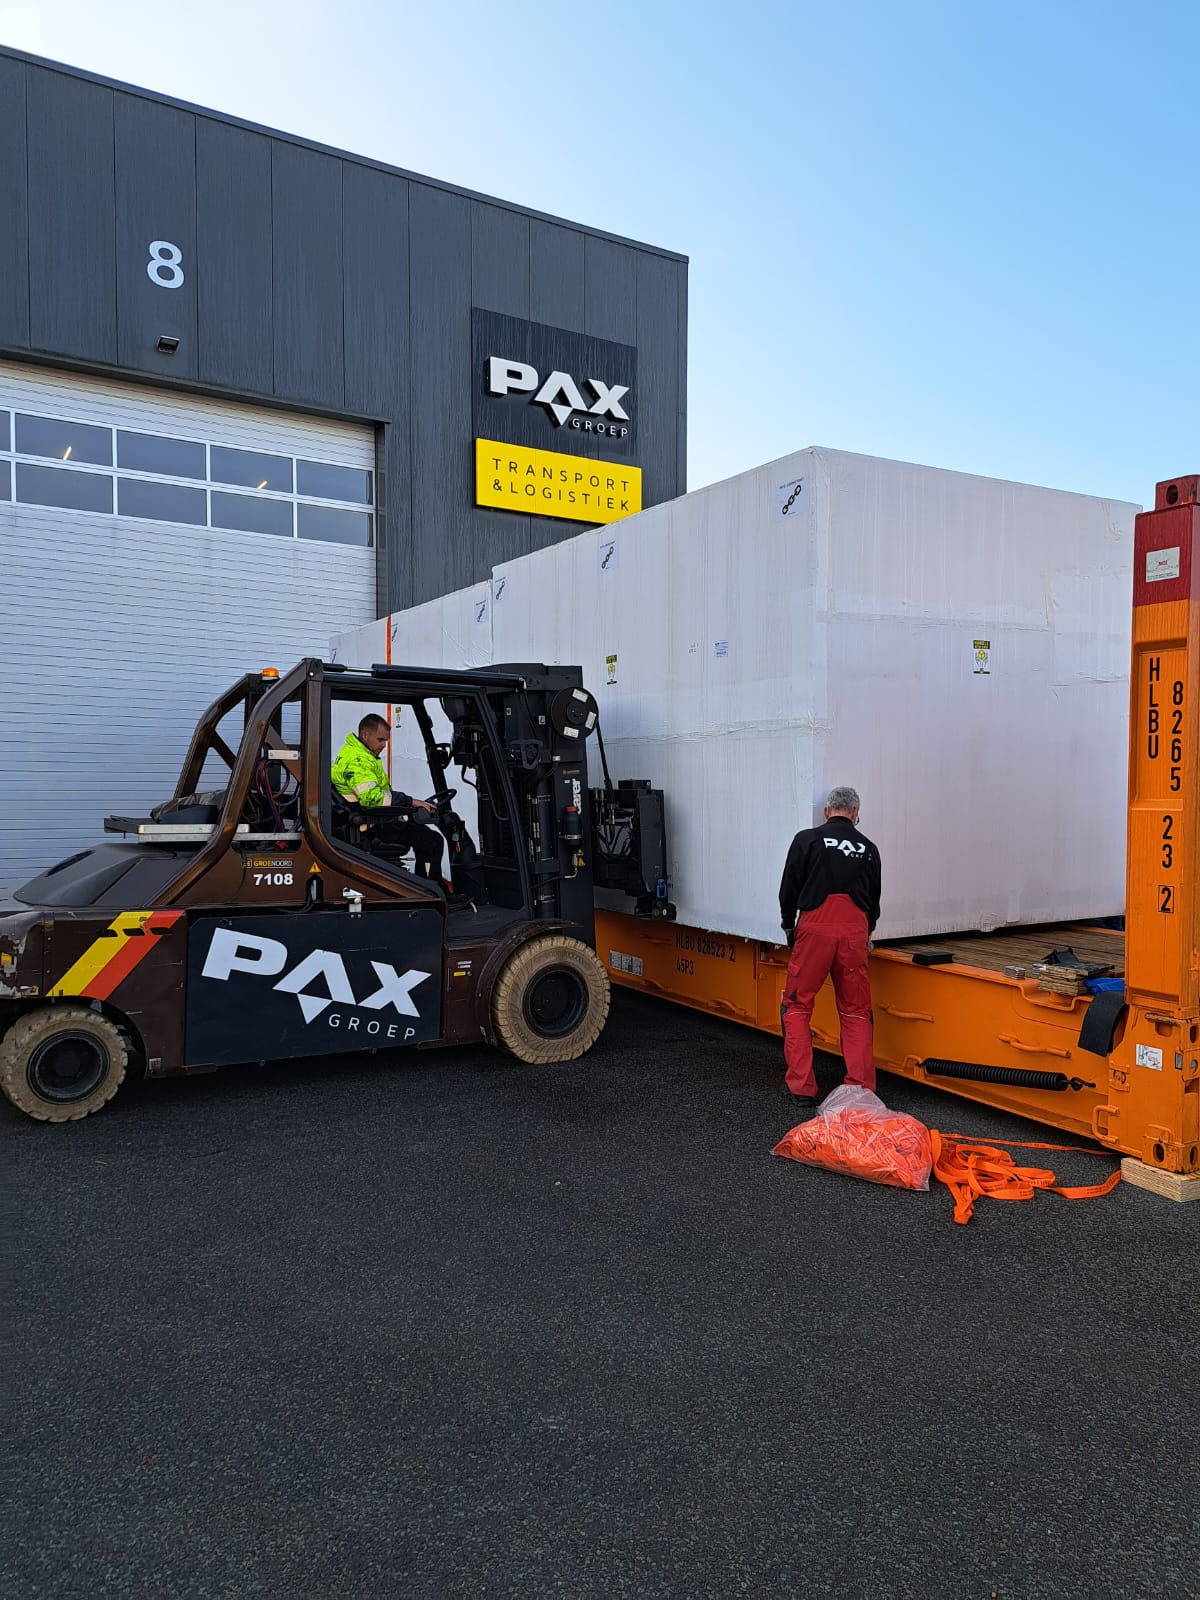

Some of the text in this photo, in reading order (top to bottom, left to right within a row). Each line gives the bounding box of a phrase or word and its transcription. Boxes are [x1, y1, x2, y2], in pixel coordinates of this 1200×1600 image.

[148, 240, 184, 288] 8
[490, 356, 630, 425] PAX
[572, 418, 628, 437] GROEP
[492, 458, 629, 492] TRANSPORT
[1148, 656, 1160, 759] HLBU
[253, 873, 293, 886] 7108
[1160, 886, 1172, 913] 2
[675, 934, 694, 950] HLBU
[201, 927, 432, 1024] PAX
[328, 1014, 416, 1041] GROEP
